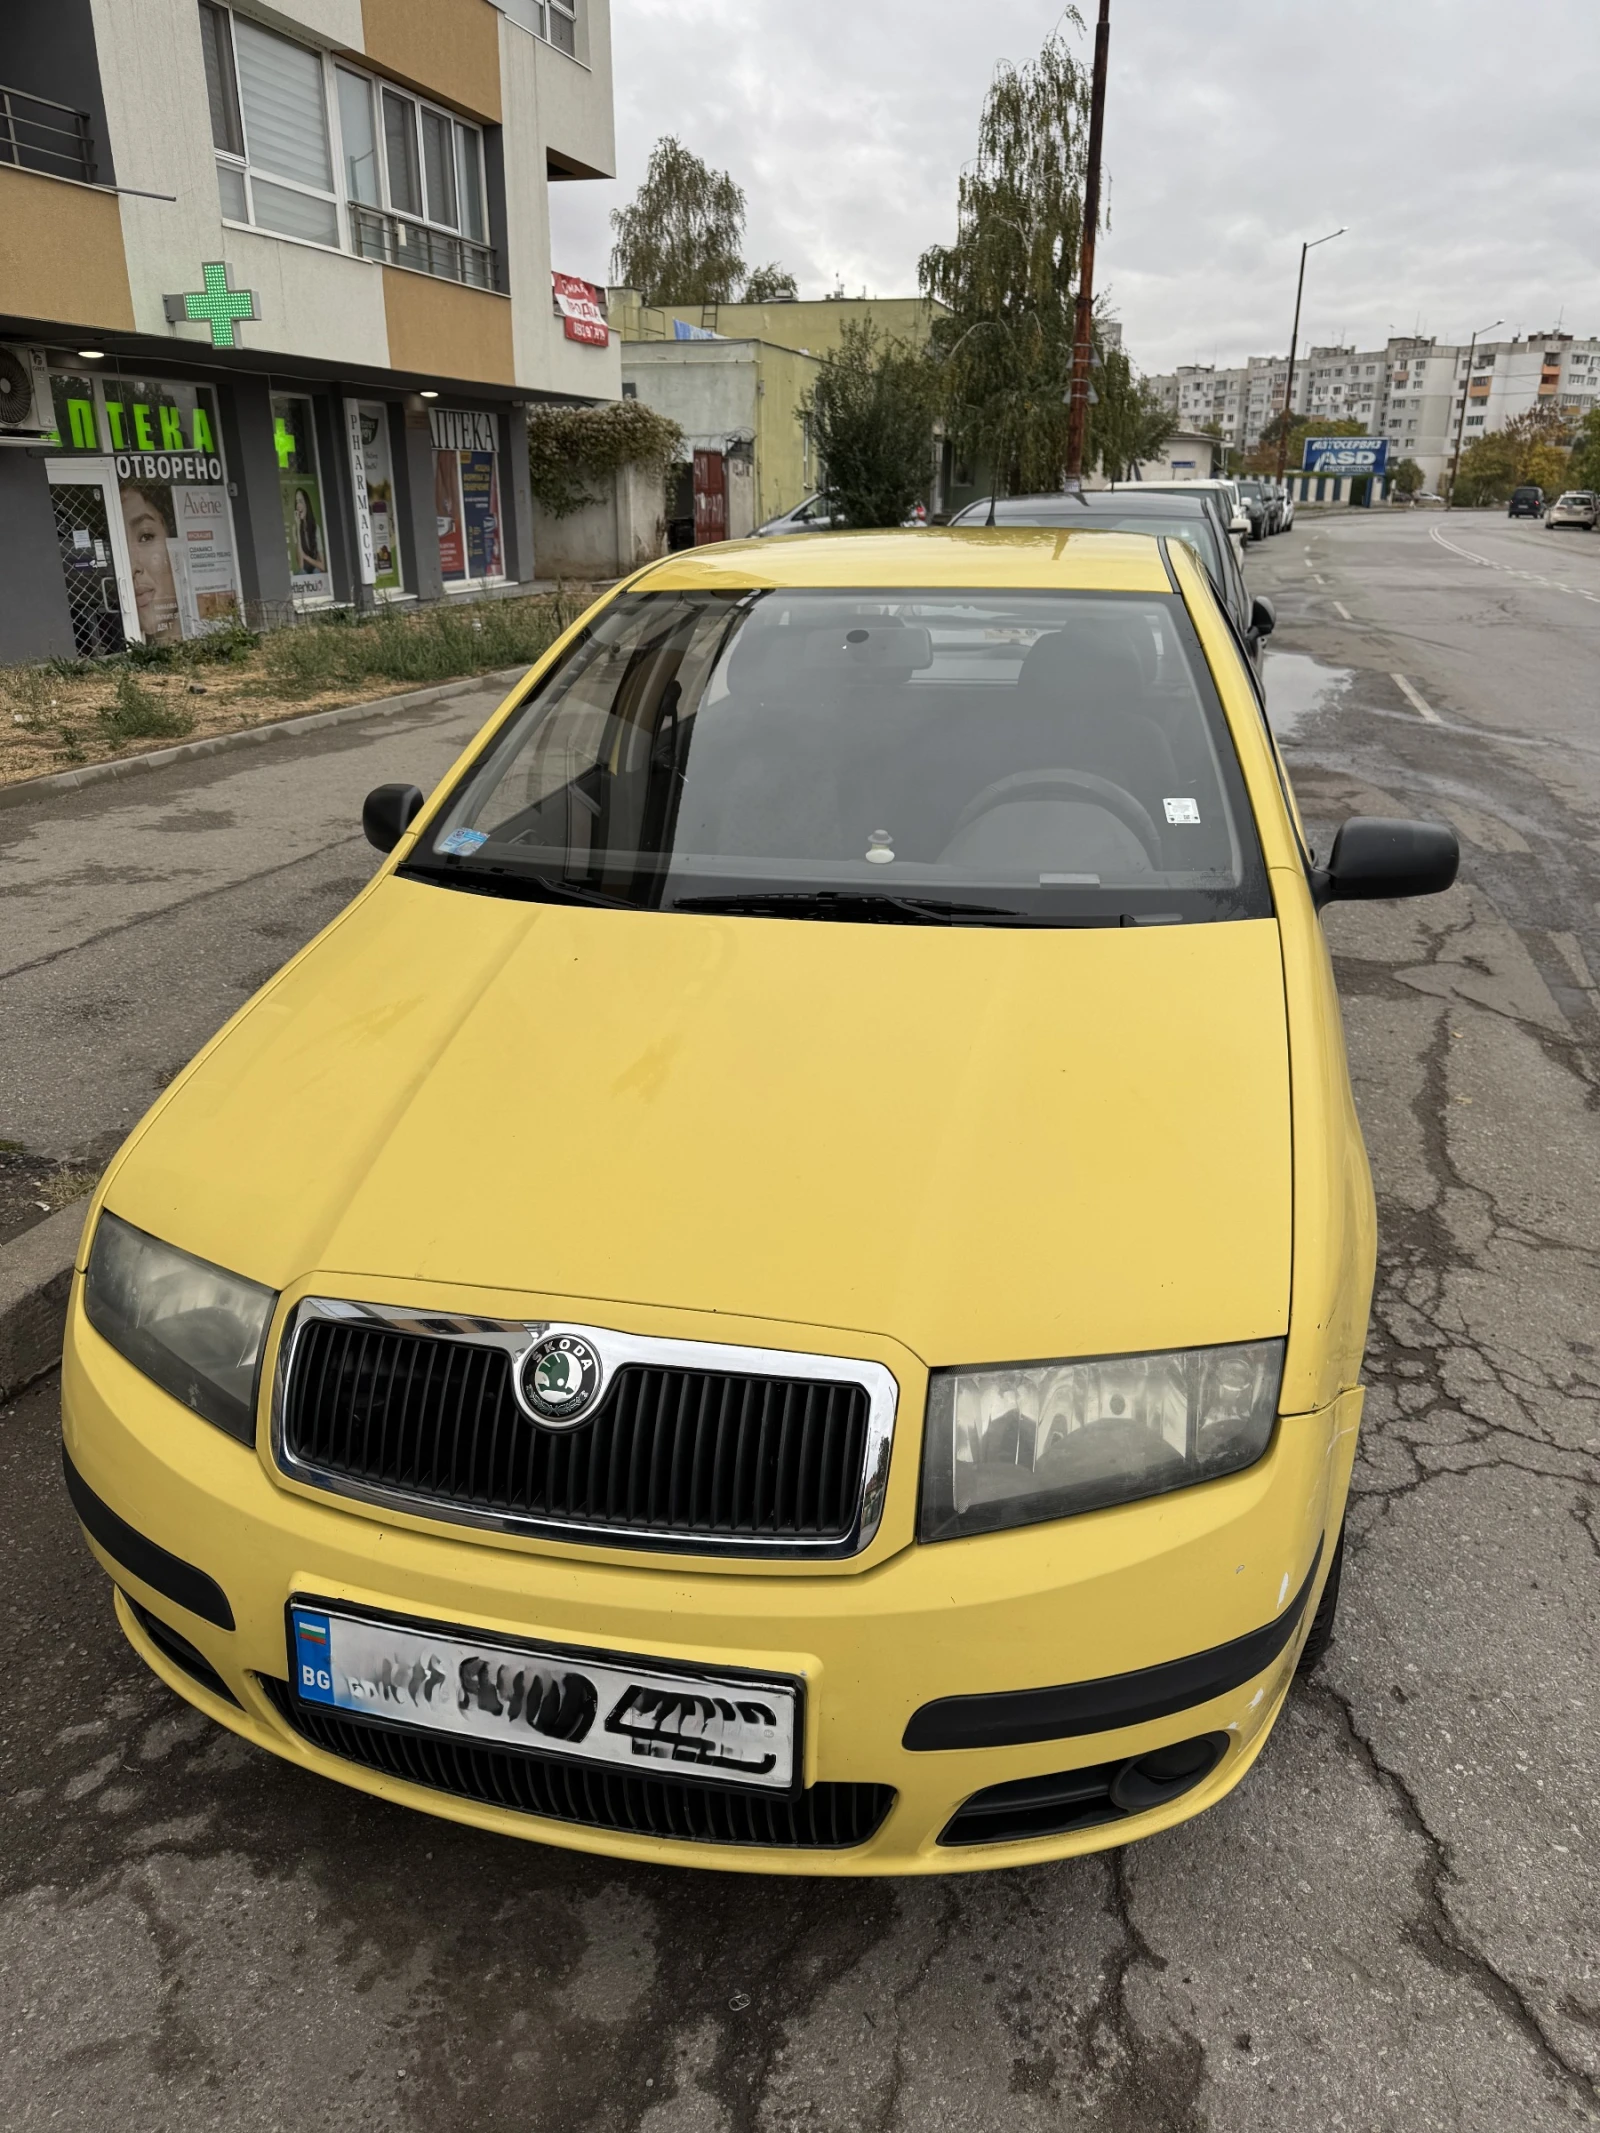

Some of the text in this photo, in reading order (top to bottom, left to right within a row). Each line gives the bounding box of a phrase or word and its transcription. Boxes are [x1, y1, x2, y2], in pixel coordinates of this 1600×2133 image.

[40, 398, 215, 453] ПТЕКА
[116, 455, 222, 481] ОТВОРЕНО
[1313, 451, 1377, 472] ASD
[183, 491, 222, 515] Avène
[350, 414, 372, 569] PHARMACY
[302, 1664, 331, 1691] BG
